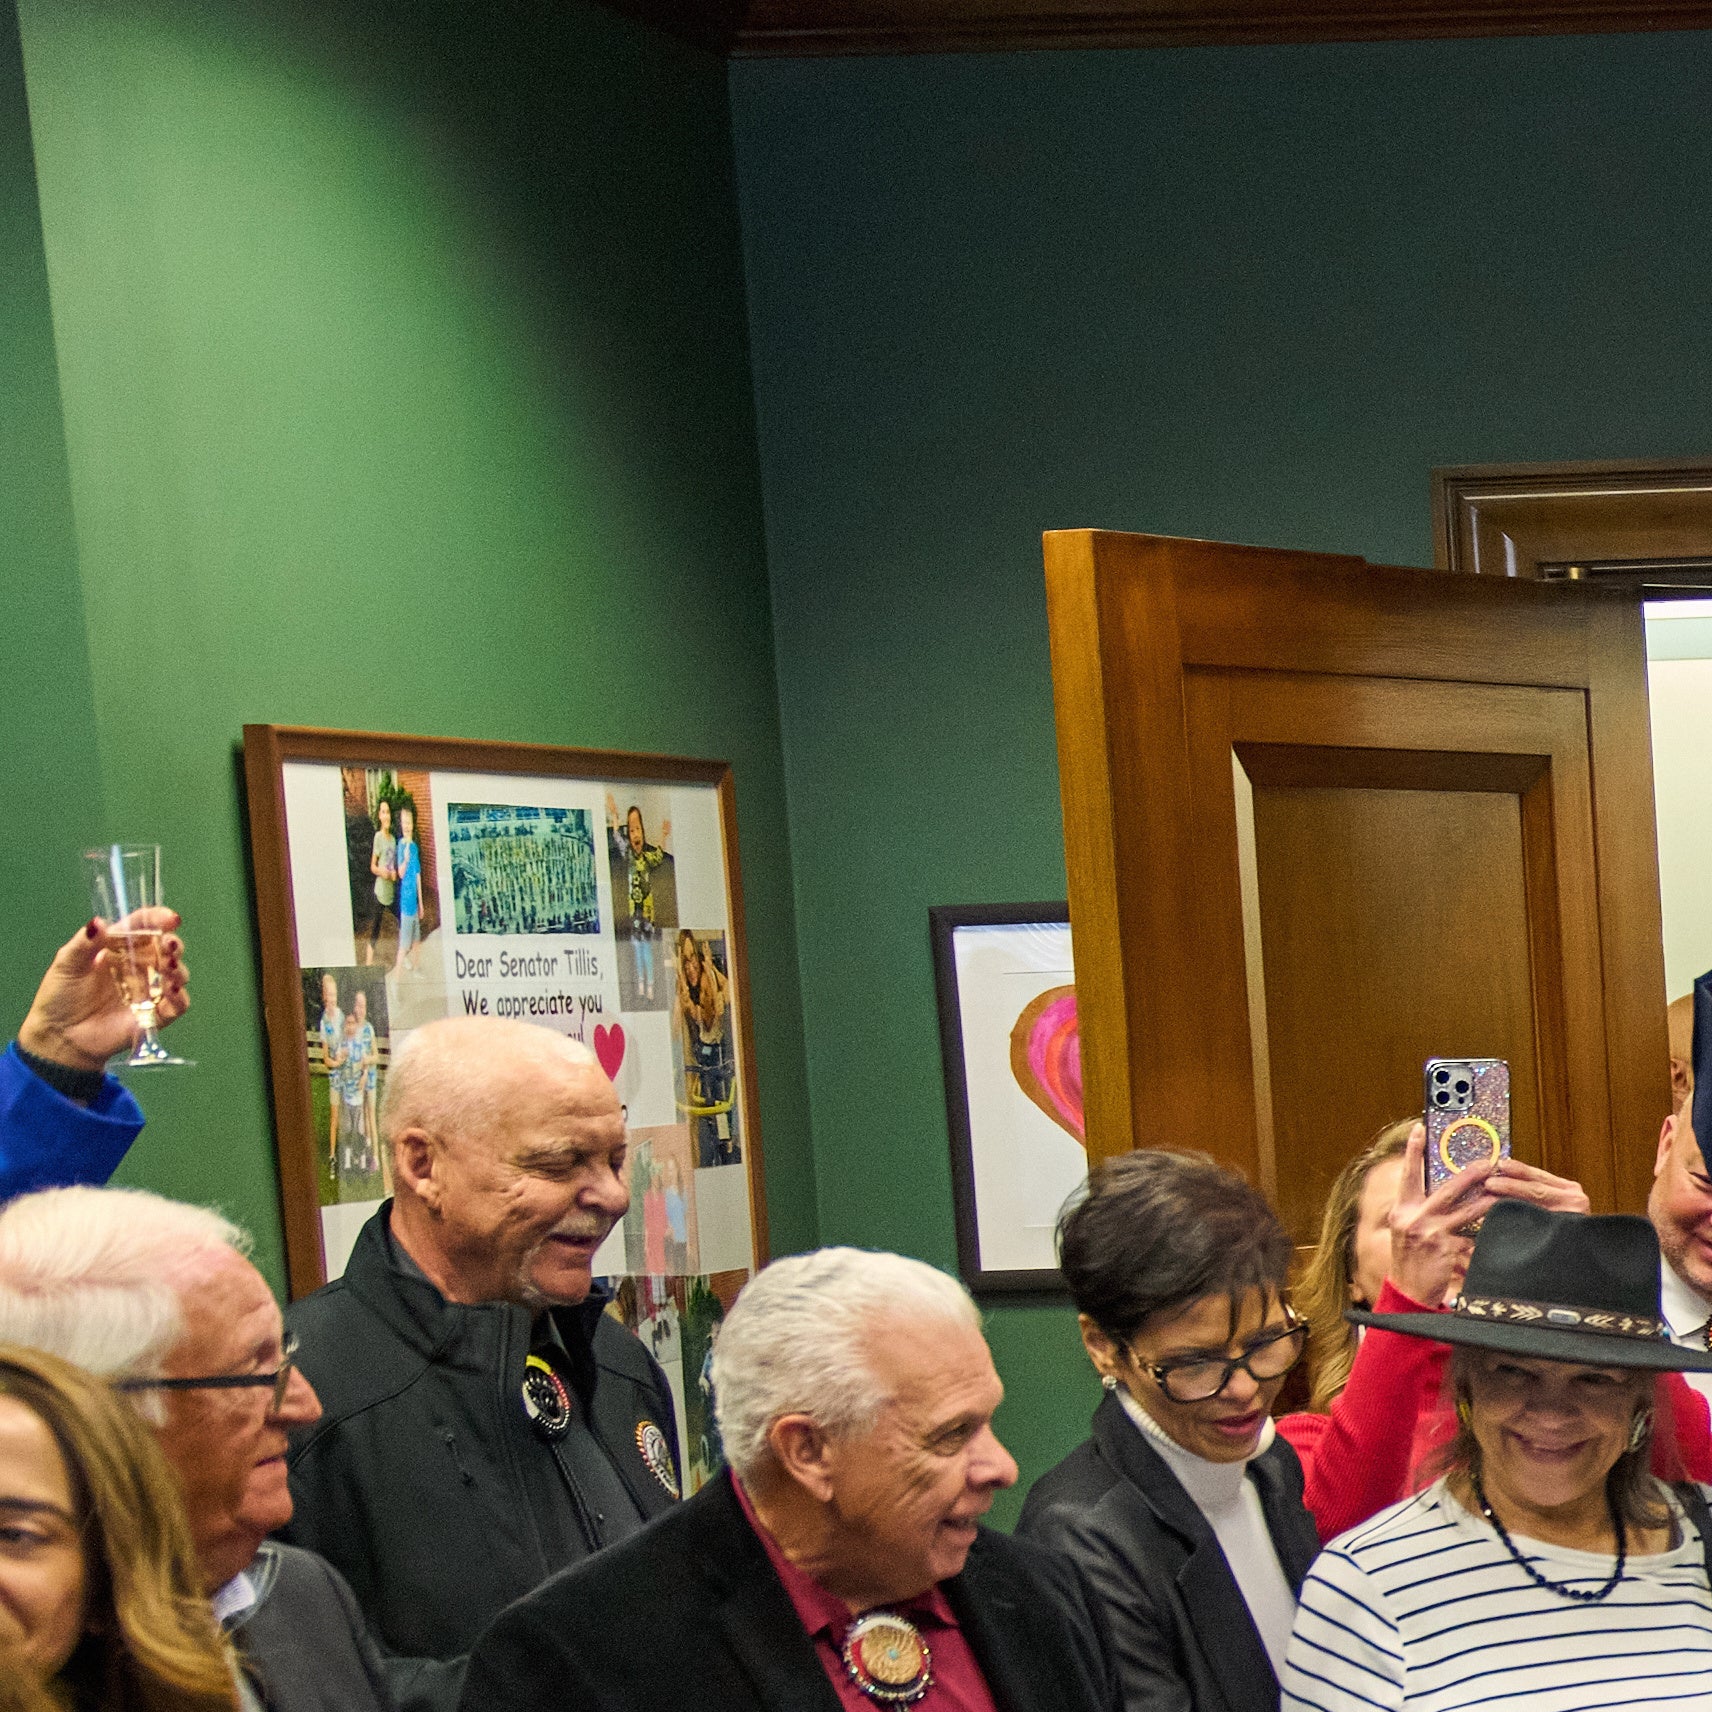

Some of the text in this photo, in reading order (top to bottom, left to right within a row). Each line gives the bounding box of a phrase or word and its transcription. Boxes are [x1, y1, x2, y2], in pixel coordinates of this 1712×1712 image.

[455, 949, 603, 980] Dear Senator Tillis,
[462, 987, 603, 1024] We appreciate you
